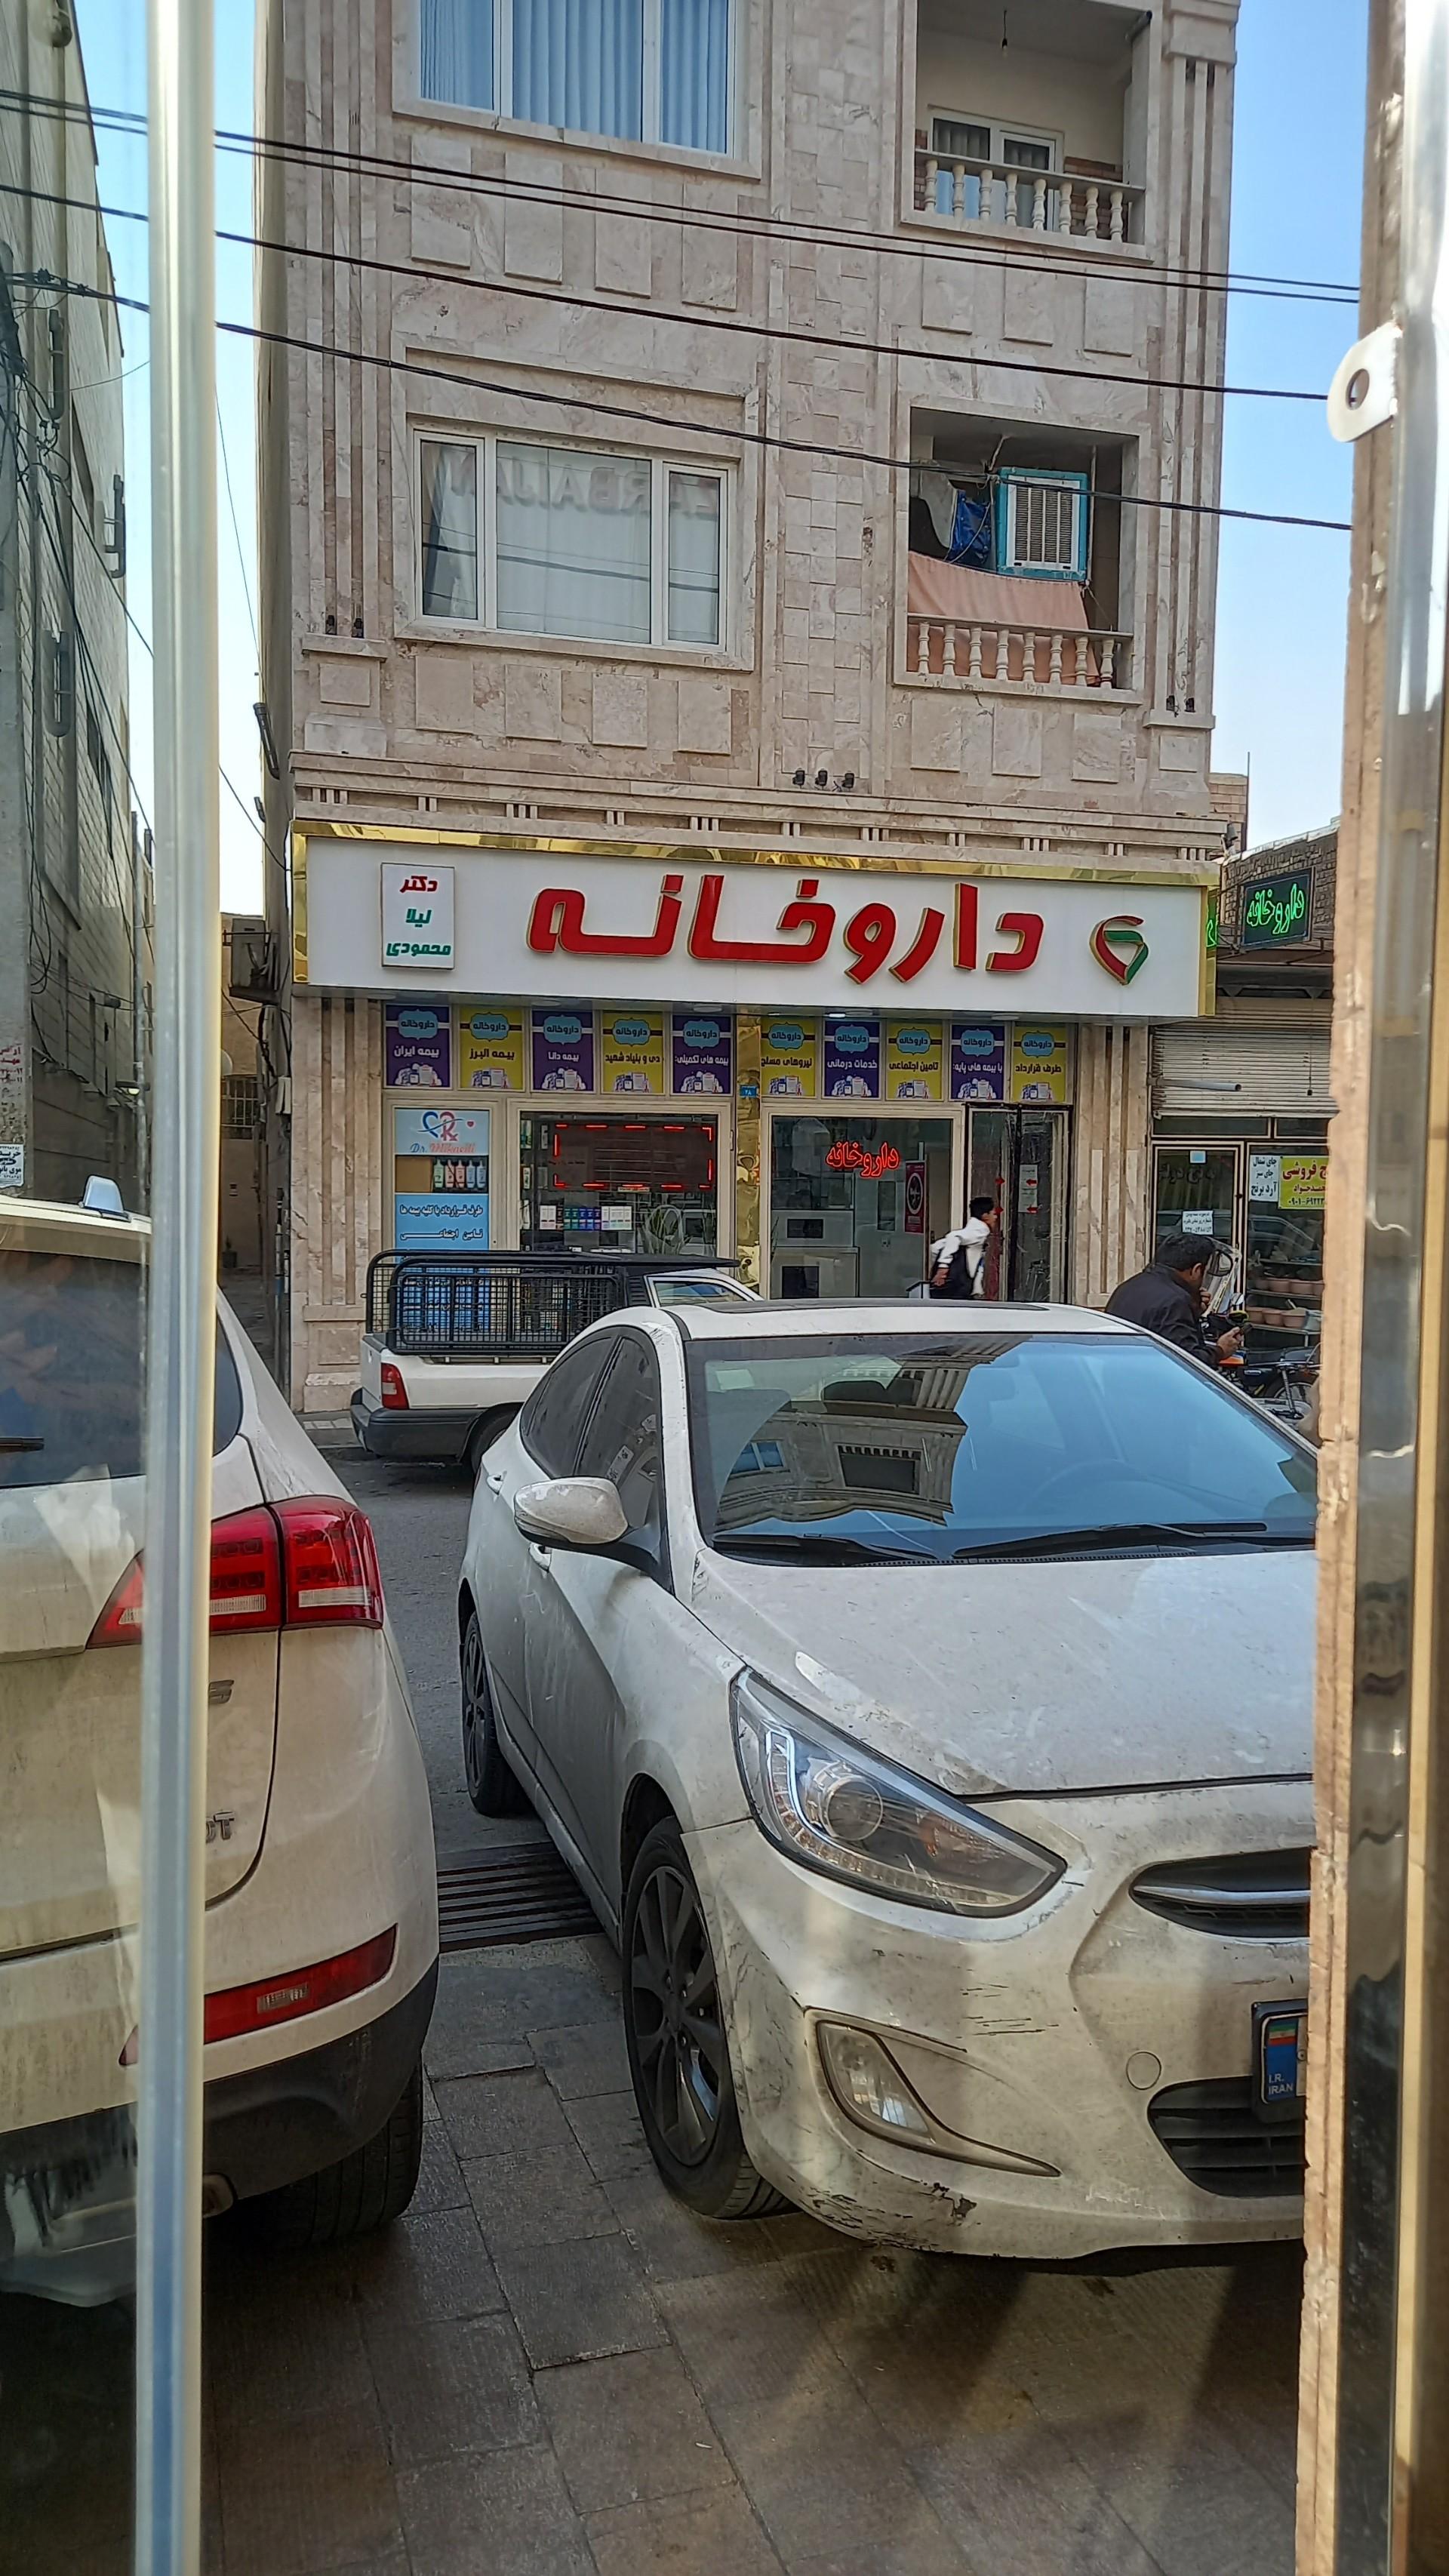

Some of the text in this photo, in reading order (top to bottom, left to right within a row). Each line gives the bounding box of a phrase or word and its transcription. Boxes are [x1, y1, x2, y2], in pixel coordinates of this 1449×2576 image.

[399, 876, 438, 893] دکتر
[1246, 882, 1304, 935] داروخانه
[405, 908, 432, 928] لیلا
[527, 874, 1044, 985] داروخانه
[386, 942, 451, 956] محمودی
[401, 1020, 435, 1030] داروخانه
[472, 1021, 506, 1032] داروخانه
[546, 1025, 579, 1035] داروخانه
[615, 1027, 648, 1037] داروخانه
[686, 1029, 717, 1039] داروخانه
[771, 1031, 801, 1042] داروخانه
[837, 1034, 866, 1044] داروخانه
[899, 1036, 928, 1046] داروخانه
[963, 1038, 992, 1048] داروخانه
[1023, 1040, 1052, 1049] داروخانه
[394, 1045, 439, 1057] بیمه ایران
[469, 1048, 515, 1060] بیمه البرز
[548, 1051, 579, 1062] بیمه دانا
[605, 1051, 624, 1063] شهید
[626, 1053, 641, 1064] بنیاد
[702, 1054, 714, 1063] های
[715, 1057, 729, 1066] بیمه
[761, 1057, 812, 1069] نیروهای مسلح
[827, 1059, 878, 1069] خدمات درمانی
[889, 1061, 939, 1072] تامین اجتماعی
[968, 1062, 981, 1071] های
[982, 1063, 996, 1073] بیمه
[1016, 1063, 1062, 1074] طرف قرارداد
[410, 1143, 427, 1153] Dr.
[825, 1140, 900, 1179] داروخانه
[1282, 1160, 1317, 1180] فروشی
[1251, 1182, 1264, 1196] برنج
[400, 1205, 408, 1214] ها
[408, 1207, 420, 1217] بیمه
[422, 1205, 434, 1216] کلیه
[441, 1205, 467, 1218] قرارداد
[468, 1205, 483, 1219] طرف
[400, 1228, 484, 1240] تامین اجتماعی
[1269, 2073, 1284, 2084] I.R.
[1269, 2083, 1294, 2095] IRAN
